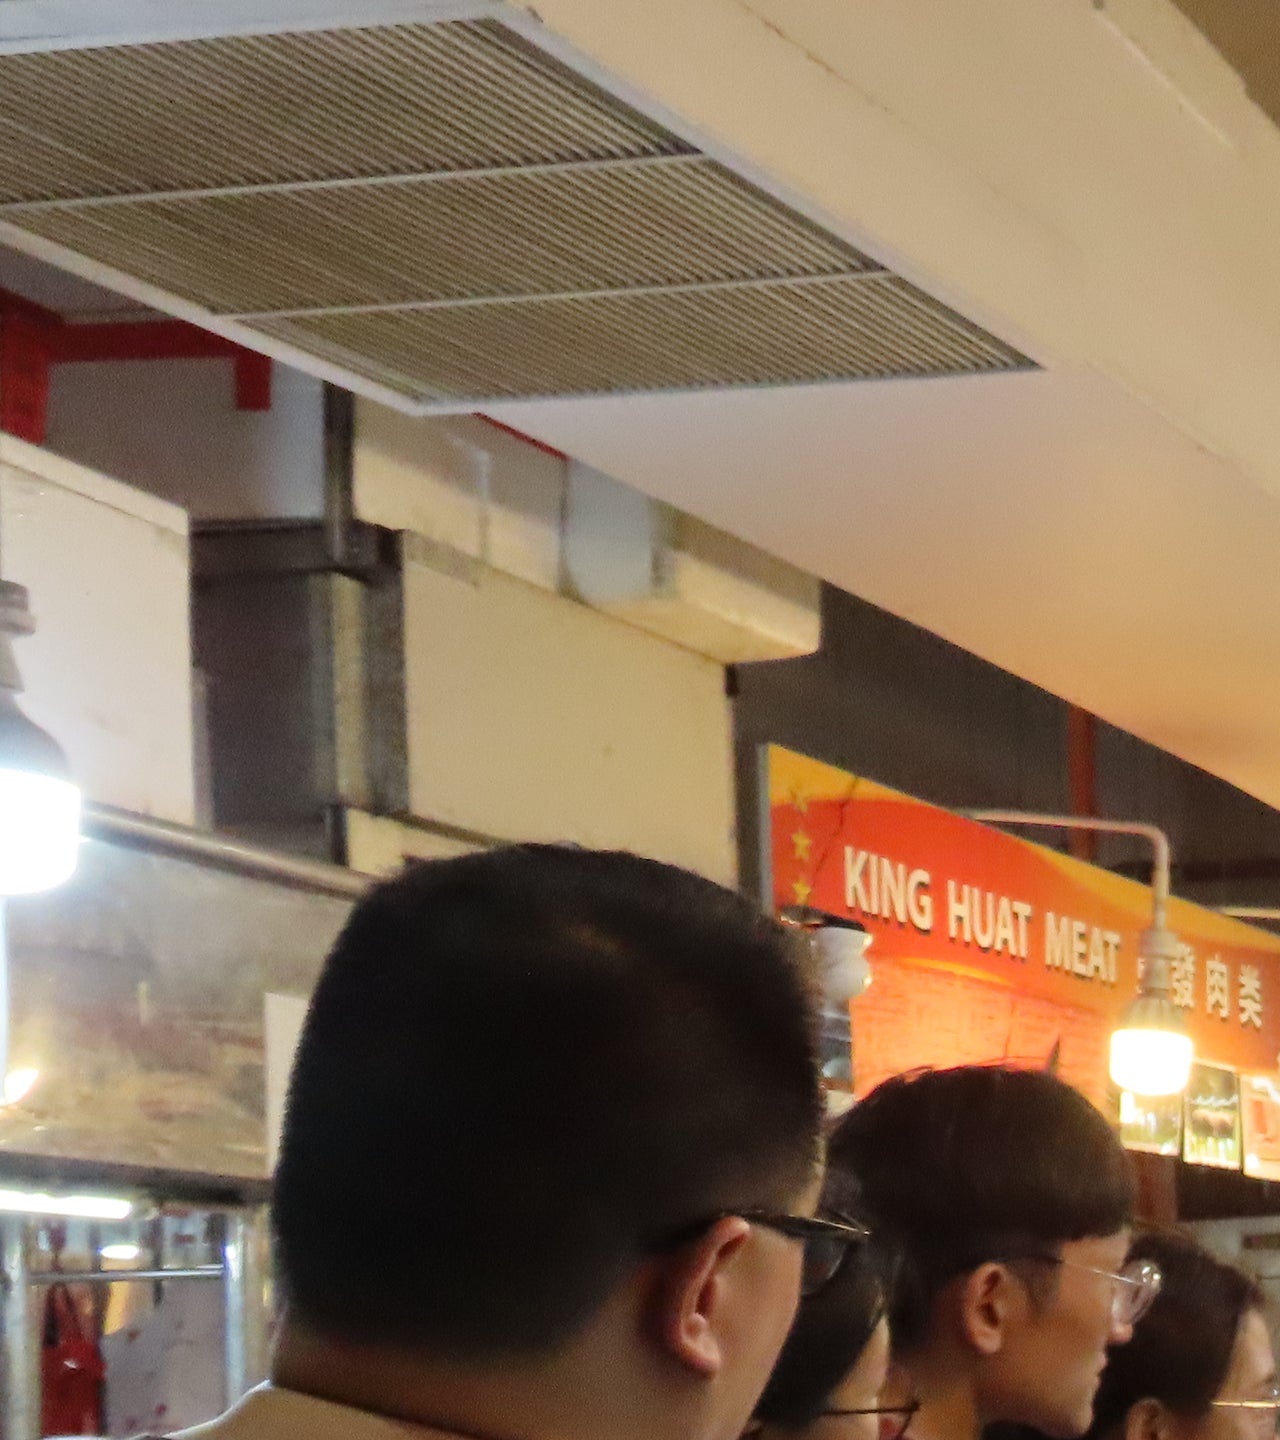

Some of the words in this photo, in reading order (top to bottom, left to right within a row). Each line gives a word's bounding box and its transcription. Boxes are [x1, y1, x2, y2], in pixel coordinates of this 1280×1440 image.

[843, 845, 933, 931] KING
[947, 878, 1032, 958] HUAT
[1045, 911, 1121, 986] MEAT
[1137, 942, 1263, 1028] 發肉类
